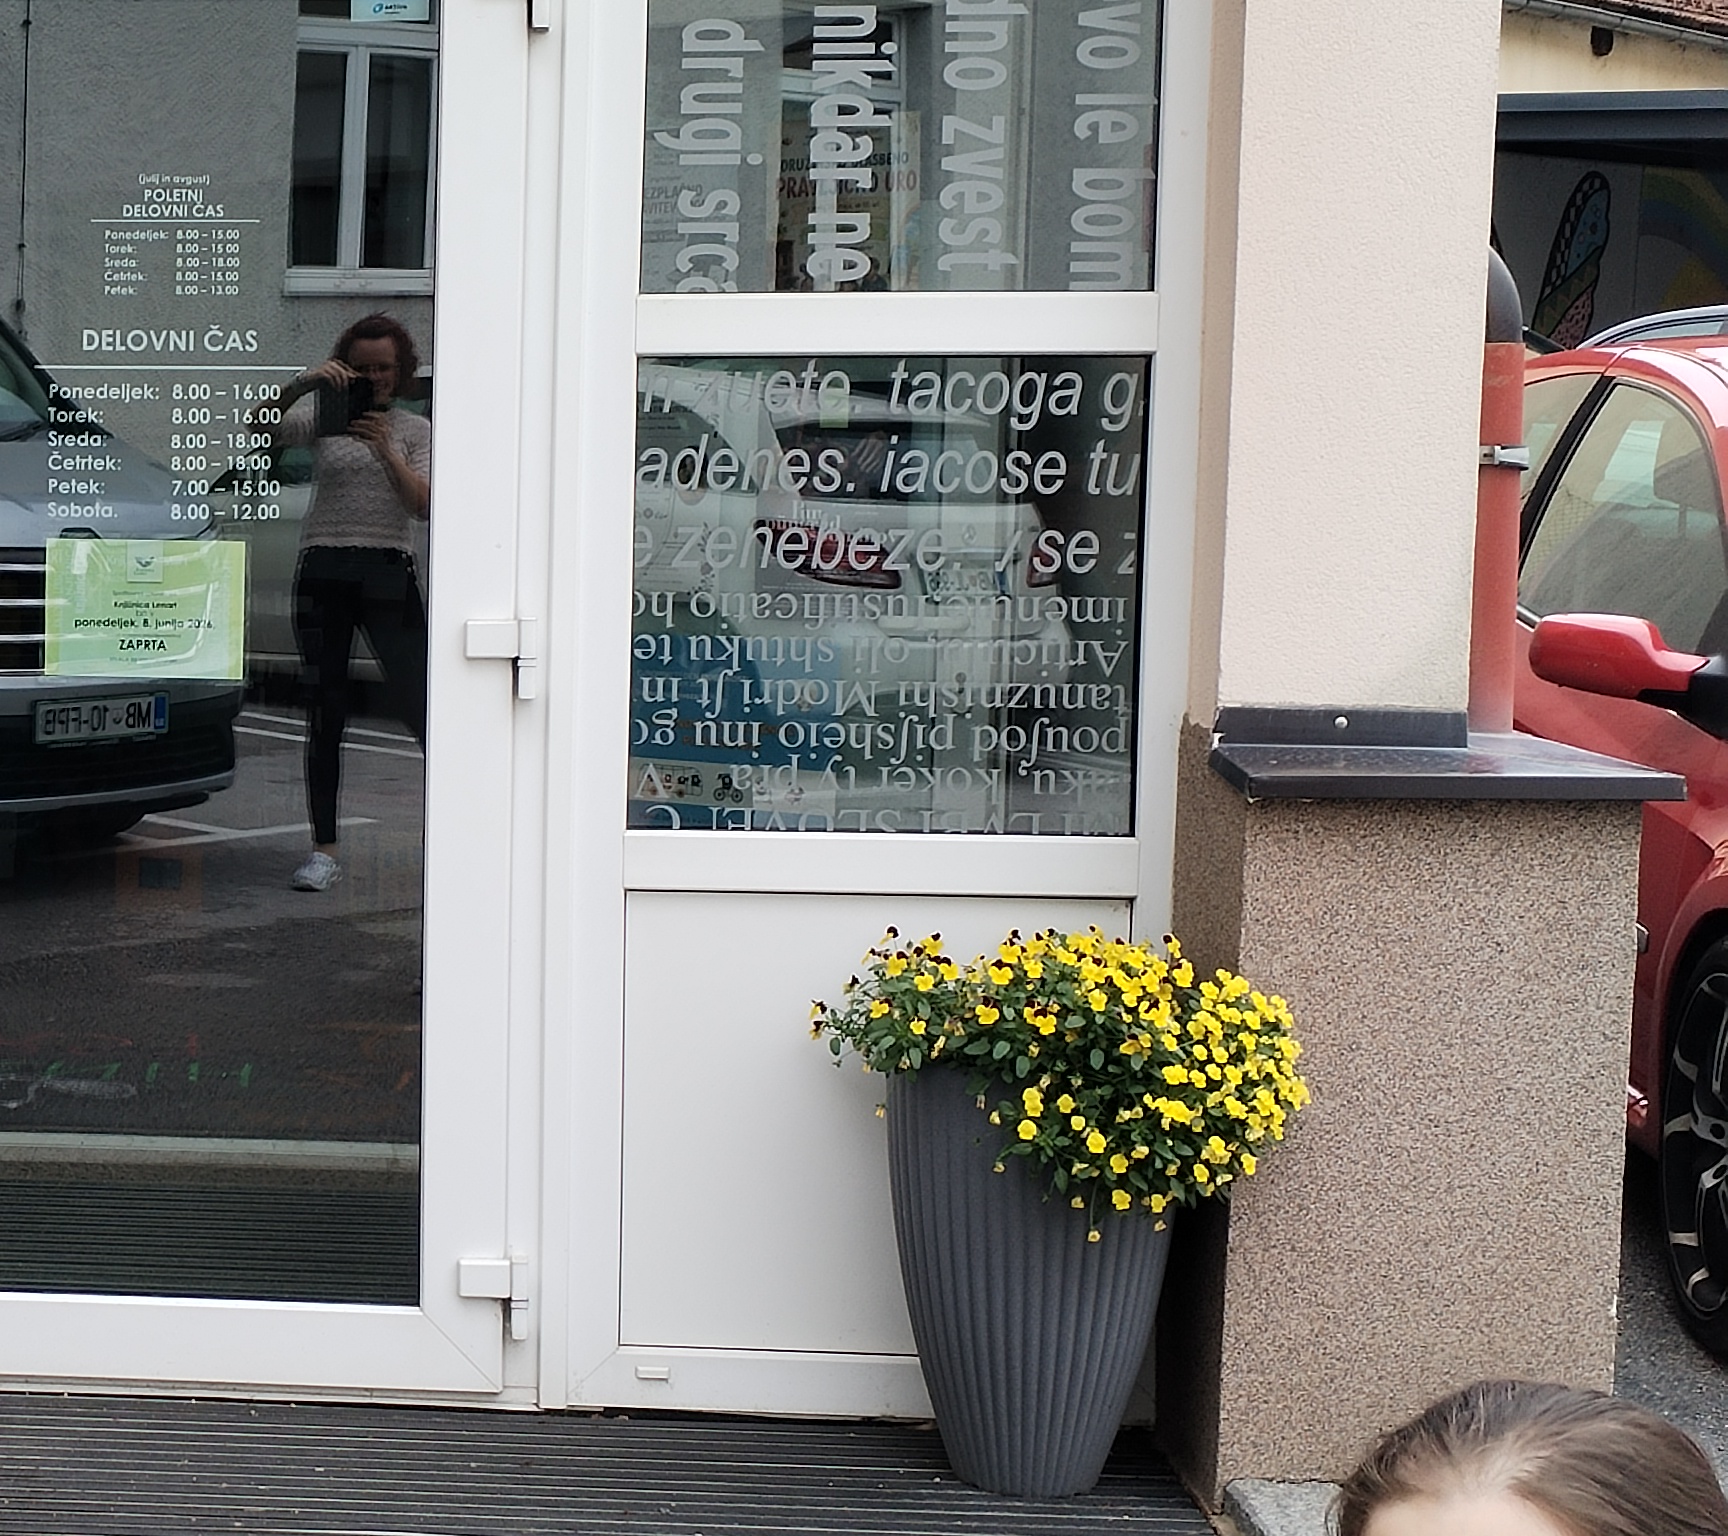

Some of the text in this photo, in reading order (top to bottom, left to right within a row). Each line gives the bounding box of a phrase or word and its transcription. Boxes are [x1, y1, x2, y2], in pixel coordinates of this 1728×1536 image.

[654, 19, 764, 166] drugi
[809, 4, 899, 193] nikdar
[1074, 94, 1158, 145] le
[123, 201, 224, 217] DELOVNI ČAS
[144, 189, 203, 202] POLETNI
[806, 212, 871, 283] ne
[82, 325, 258, 352] DELOVNI ČAS
[48, 383, 281, 403] Ponedeljek: 8.00 16.00
[890, 358, 1084, 430] tacoga
[48, 407, 281, 424] Torek: 8.00 16.00
[48, 431, 272, 449] Sreda: 8.00 18.00
[48, 451, 272, 471] Četrtek: 8.00 18.00
[880, 435, 1066, 494] iacose
[48, 479, 281, 496] Petek: 7.00 15.00
[171, 504, 280, 520] 8.00 12.00
[687, 634, 834, 673] shtuku
[740, 679, 878, 716] Modri
[694, 720, 764, 758] inu
[817, 755, 855, 791] ty
[872, 766, 1001, 804] koker
